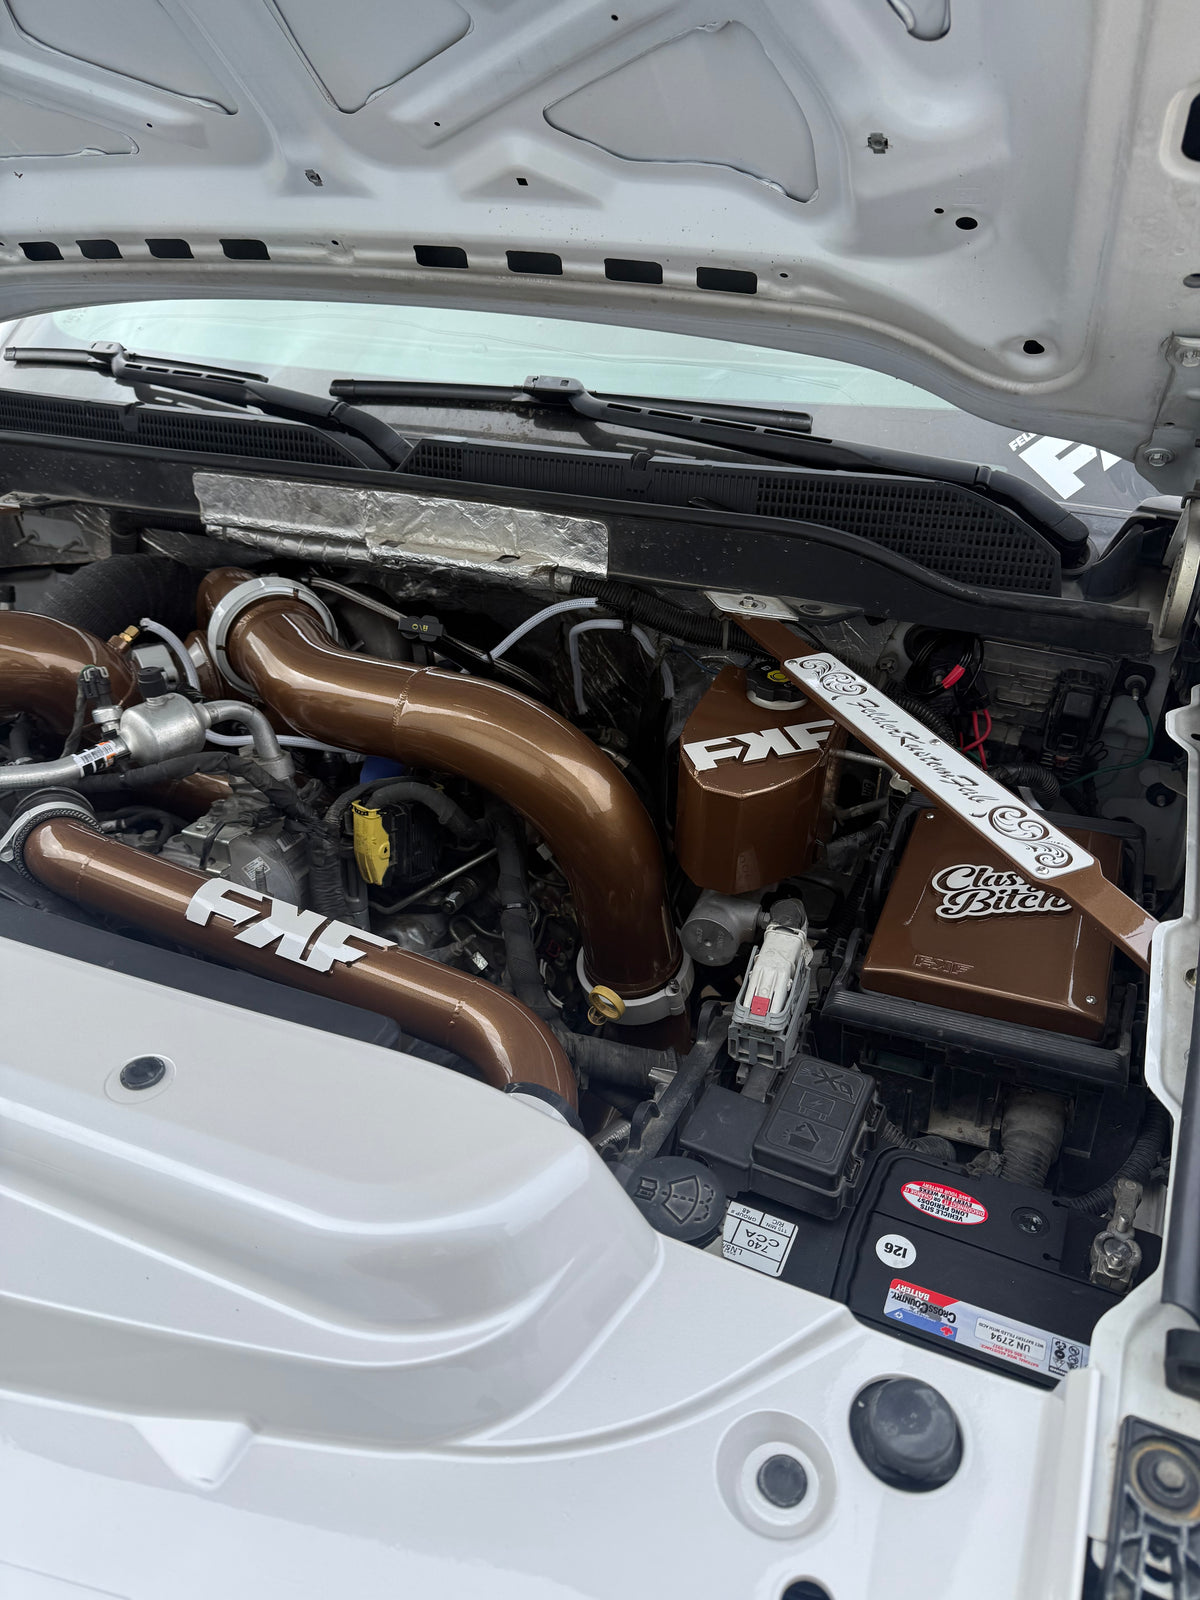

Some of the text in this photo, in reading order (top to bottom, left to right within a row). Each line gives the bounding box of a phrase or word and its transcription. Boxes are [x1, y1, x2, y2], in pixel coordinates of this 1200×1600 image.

[683, 719, 835, 772] FKF
[185, 877, 399, 973] FKF
[919, 1186, 973, 1208] EVERY FEW WEEKS
[736, 1211, 757, 1222] GROUP
[917, 1198, 969, 1218] LONG PERIODS?
[920, 1204, 963, 1222] VEHICLE SITS
[745, 1229, 780, 1248] CCA
[747, 1239, 769, 1254] 740
[895, 1283, 930, 1301] BATTERY
[990, 1332, 1031, 1353] UN 2794
